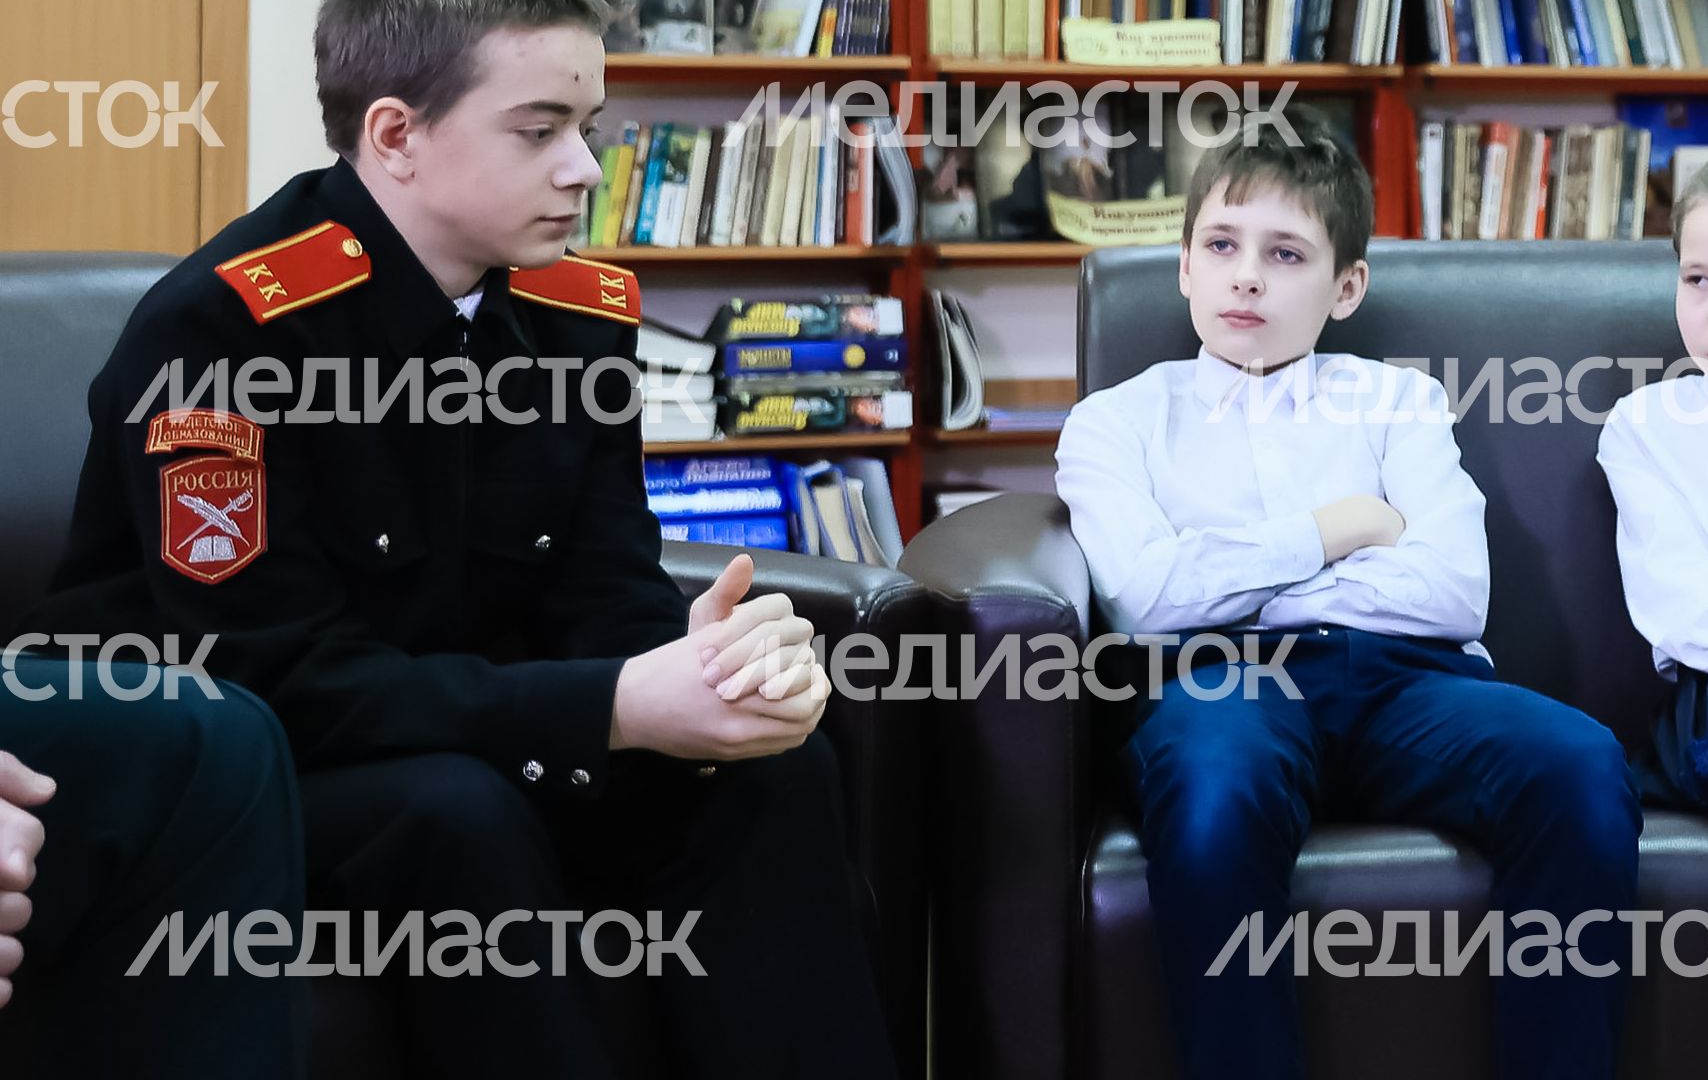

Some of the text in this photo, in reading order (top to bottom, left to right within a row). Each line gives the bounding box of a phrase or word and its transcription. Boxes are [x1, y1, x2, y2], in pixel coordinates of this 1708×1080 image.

[243, 262, 288, 303] КК
[598, 271, 627, 309] КК
[170, 416, 243, 434] КАДЕТСКОЕ
[163, 429, 249, 448] ОБРАЗОВАНИЕ
[173, 470, 255, 493] РОССИЯ
